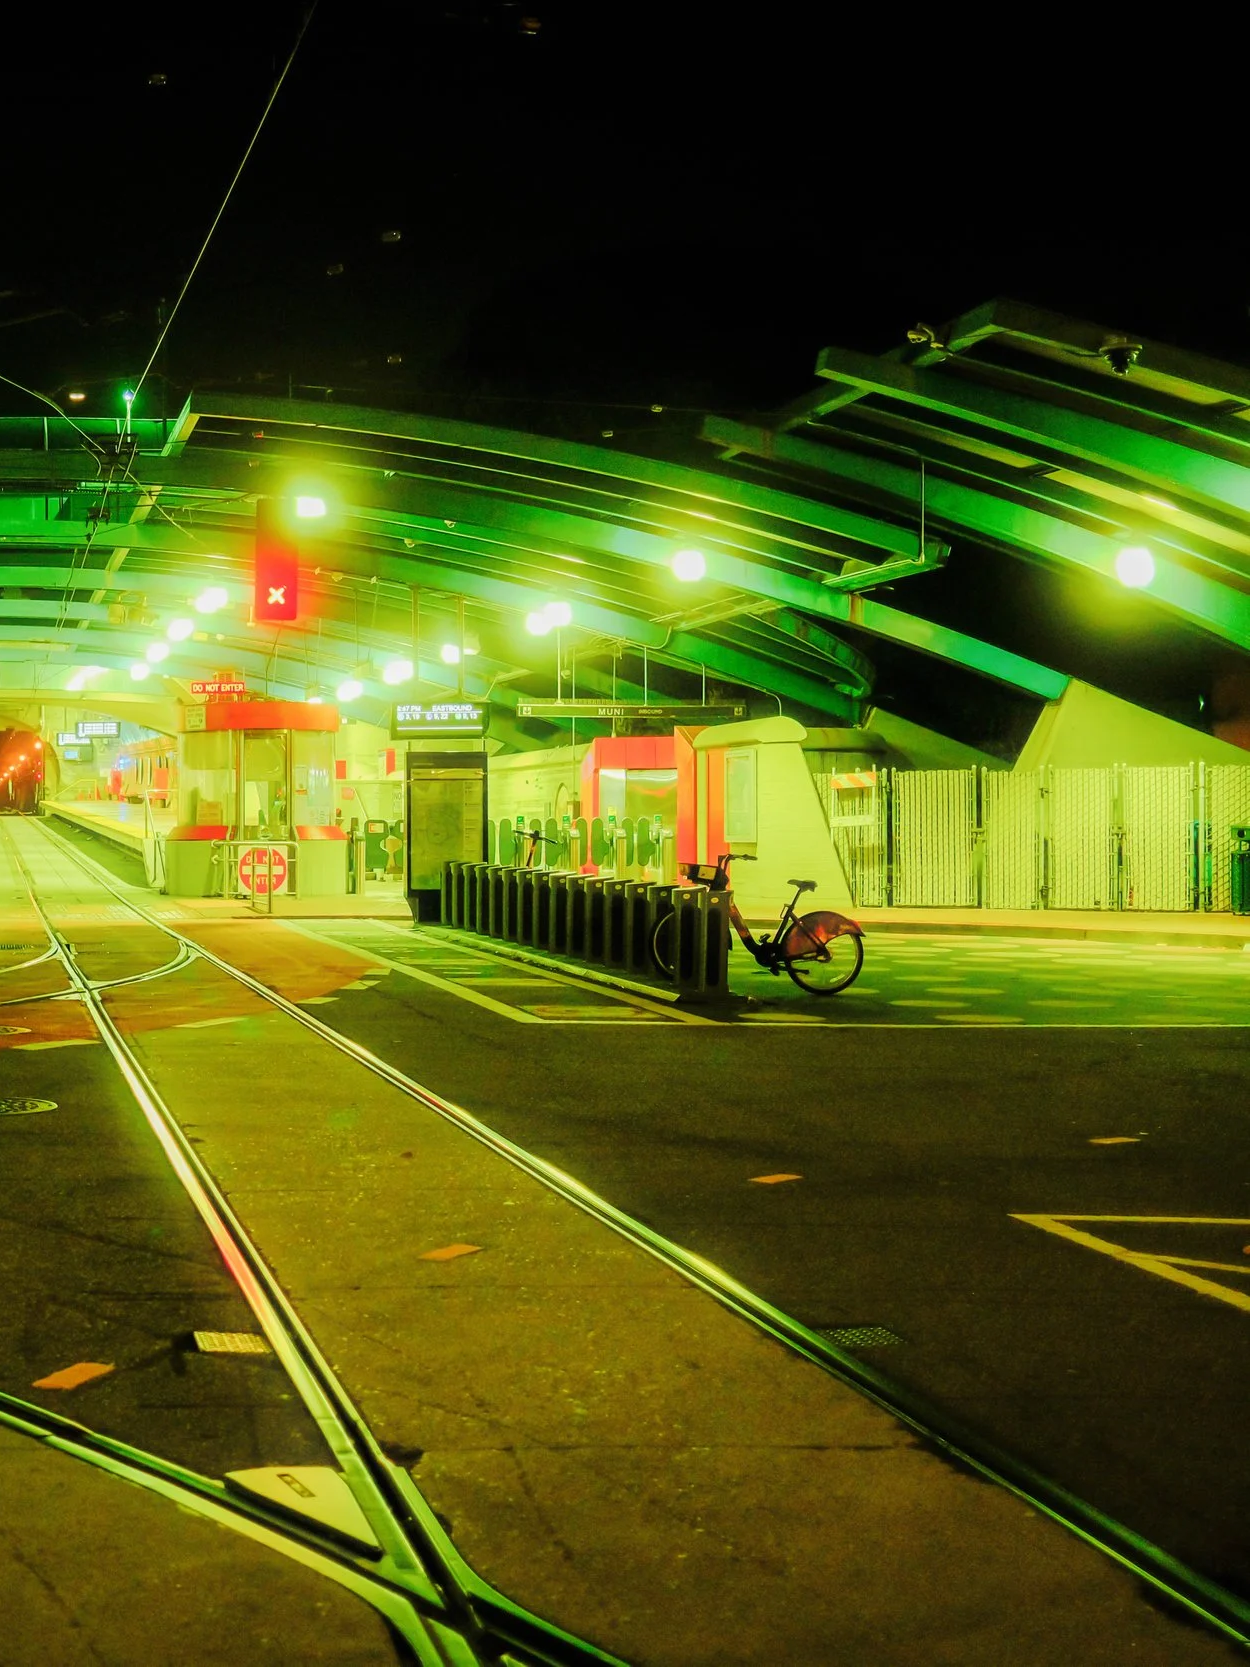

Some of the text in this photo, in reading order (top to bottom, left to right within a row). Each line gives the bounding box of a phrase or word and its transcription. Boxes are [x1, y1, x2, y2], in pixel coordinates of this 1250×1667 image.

[192, 684, 244, 692] DO NOT ENTER
[432, 704, 472, 712] EASTBOUND
[598, 708, 624, 716] MUNI
